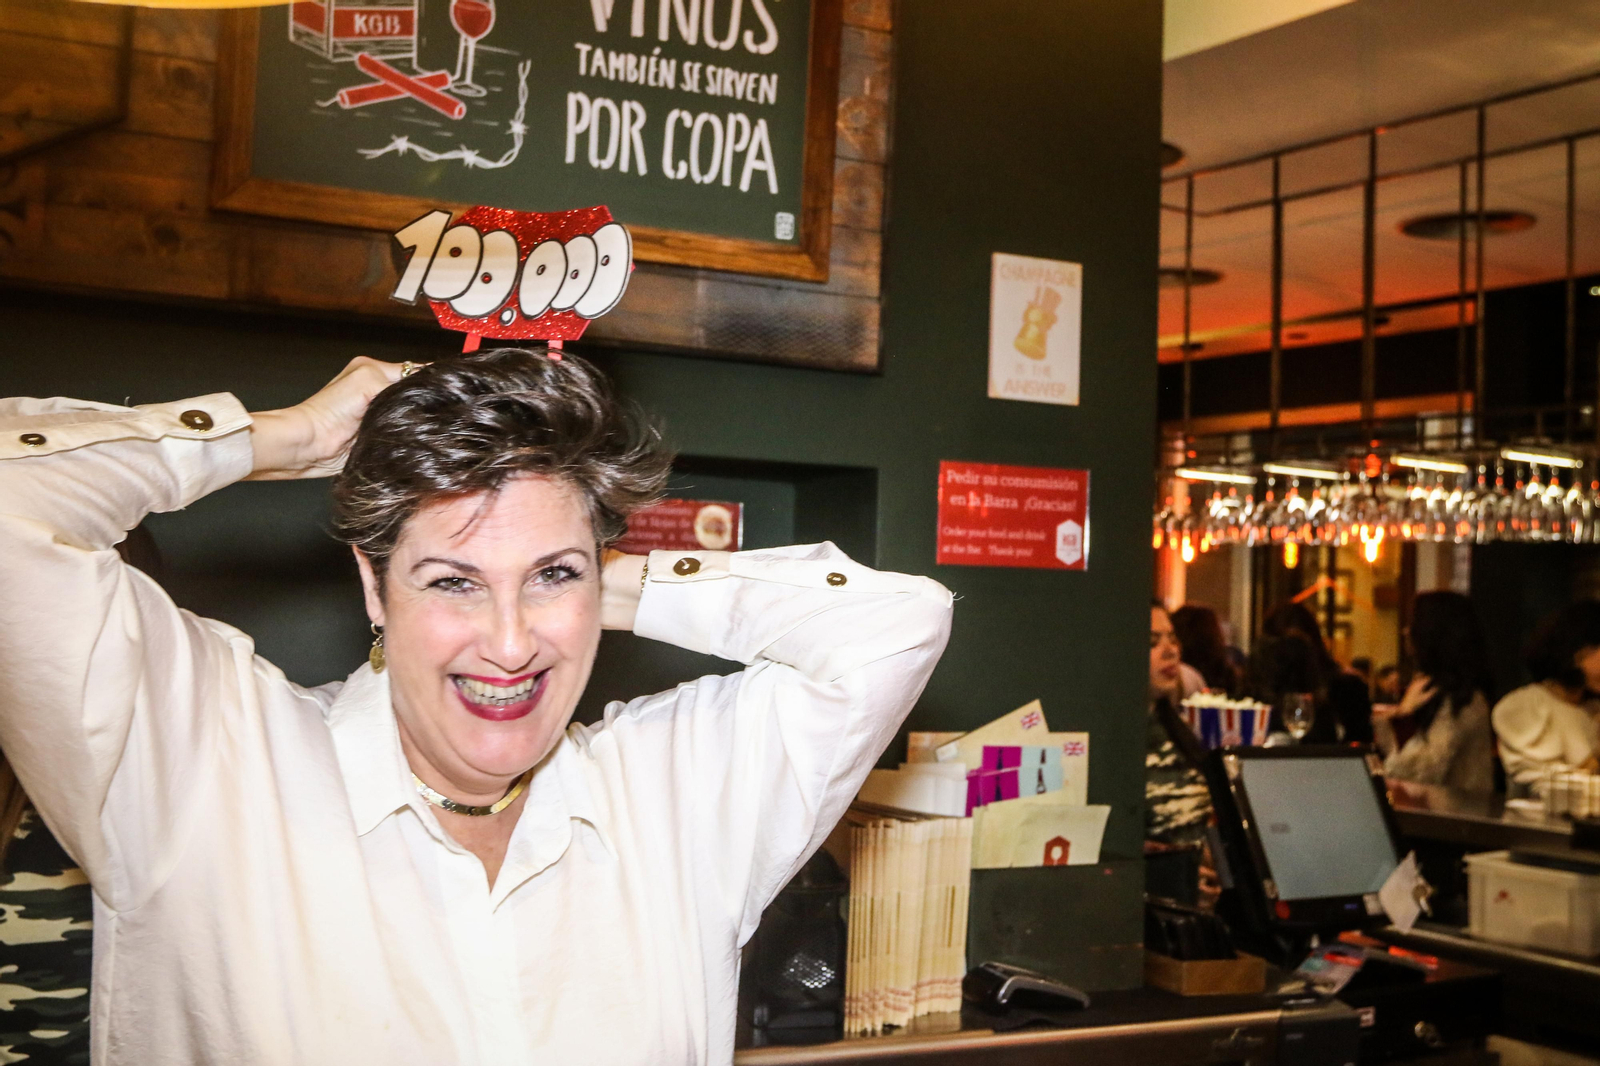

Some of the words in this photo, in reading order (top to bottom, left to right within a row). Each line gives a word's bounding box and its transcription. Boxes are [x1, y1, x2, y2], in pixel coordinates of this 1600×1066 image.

[353, 12, 401, 35] KGB
[574, 41, 676, 90] TAMBIÉN
[680, 60, 702, 93] SE
[705, 64, 778, 105] SIRVEN
[565, 91, 648, 177] POR
[662, 108, 779, 195] COPA
[946, 469, 980, 485] Pedir
[982, 475, 998, 486] su
[949, 494, 966, 506] en
[969, 491, 981, 507] la
[983, 493, 1019, 509] Barra
